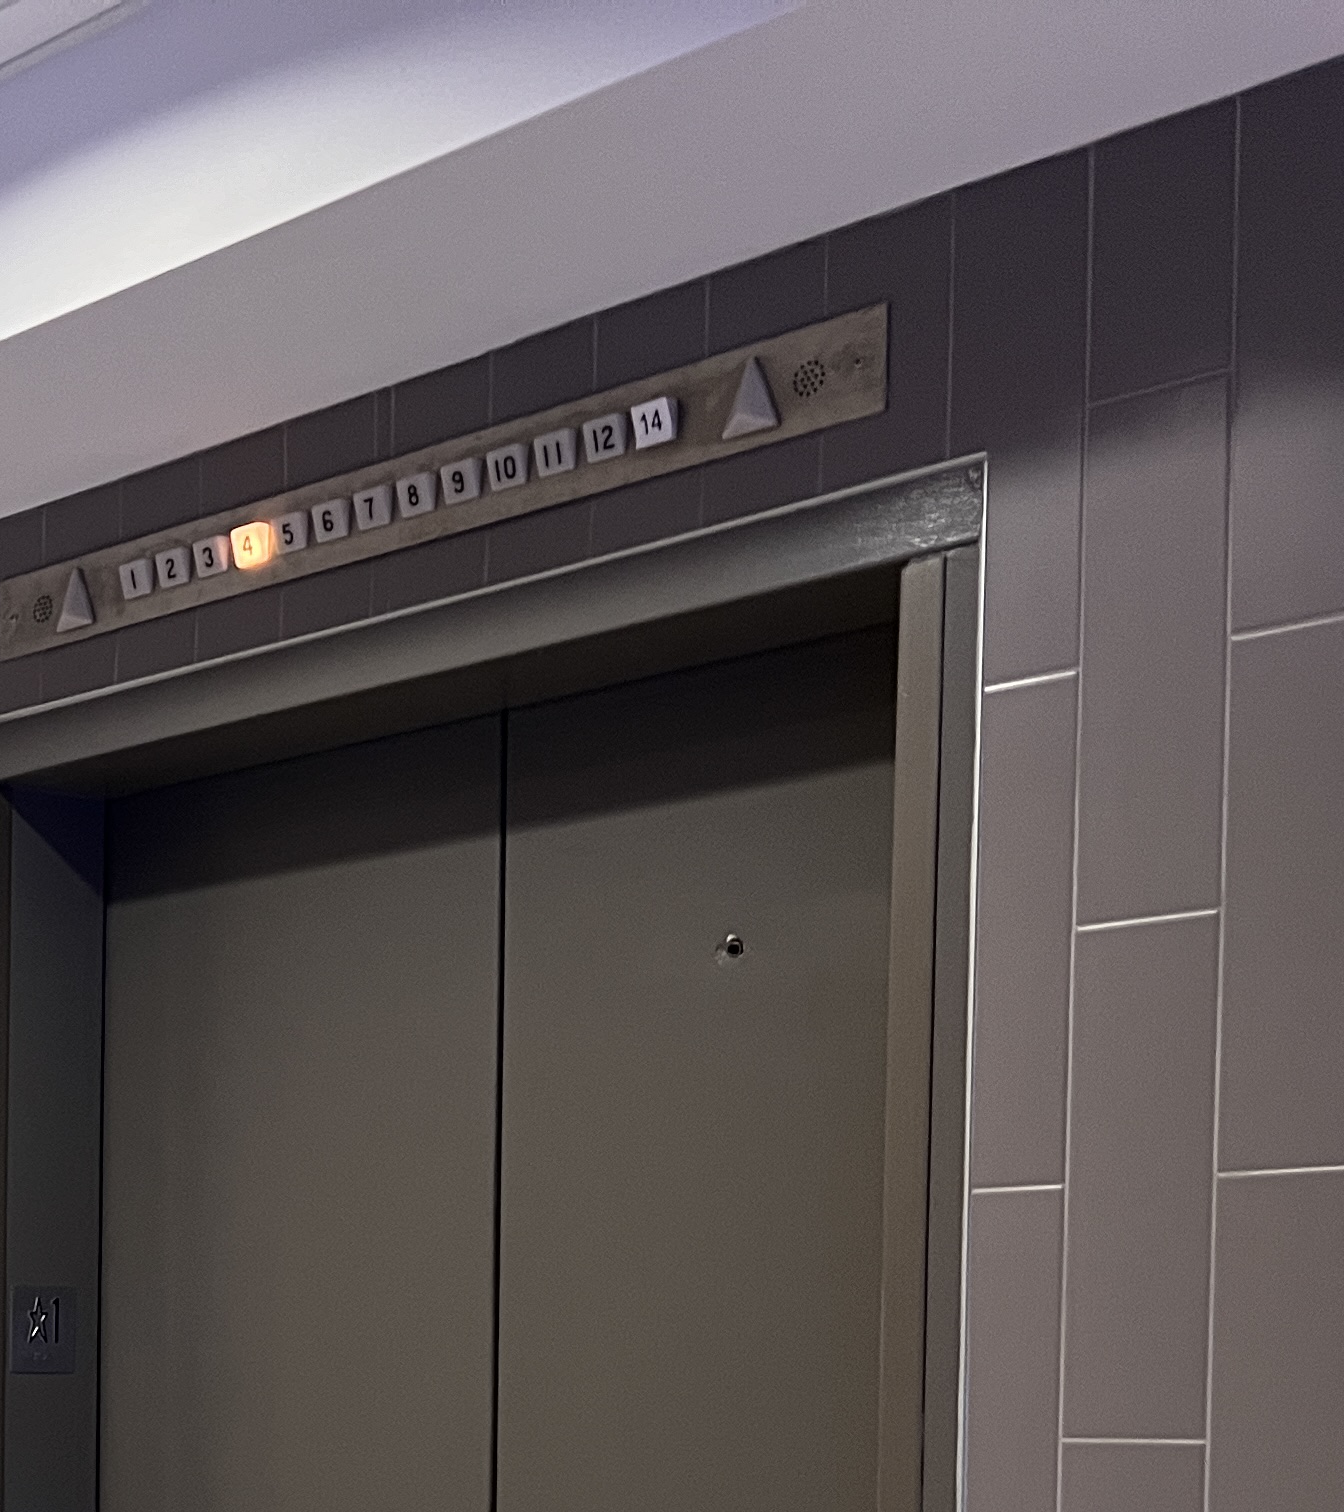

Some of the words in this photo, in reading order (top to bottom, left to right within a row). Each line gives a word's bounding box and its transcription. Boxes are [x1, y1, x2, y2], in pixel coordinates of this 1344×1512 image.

[130, 569, 137, 589] 1
[165, 558, 177, 579] 2
[202, 547, 214, 568] 3
[242, 535, 253, 556] 4
[282, 522, 294, 545] 5
[322, 510, 334, 532] 6
[363, 497, 375, 519] 7
[407, 485, 419, 506] 8
[452, 470, 464, 493] 9
[494, 455, 517, 483] 10
[543, 440, 562, 469] 11
[592, 425, 615, 453] 12
[640, 408, 662, 435] 14
[50, 1297, 60, 1344] 1
